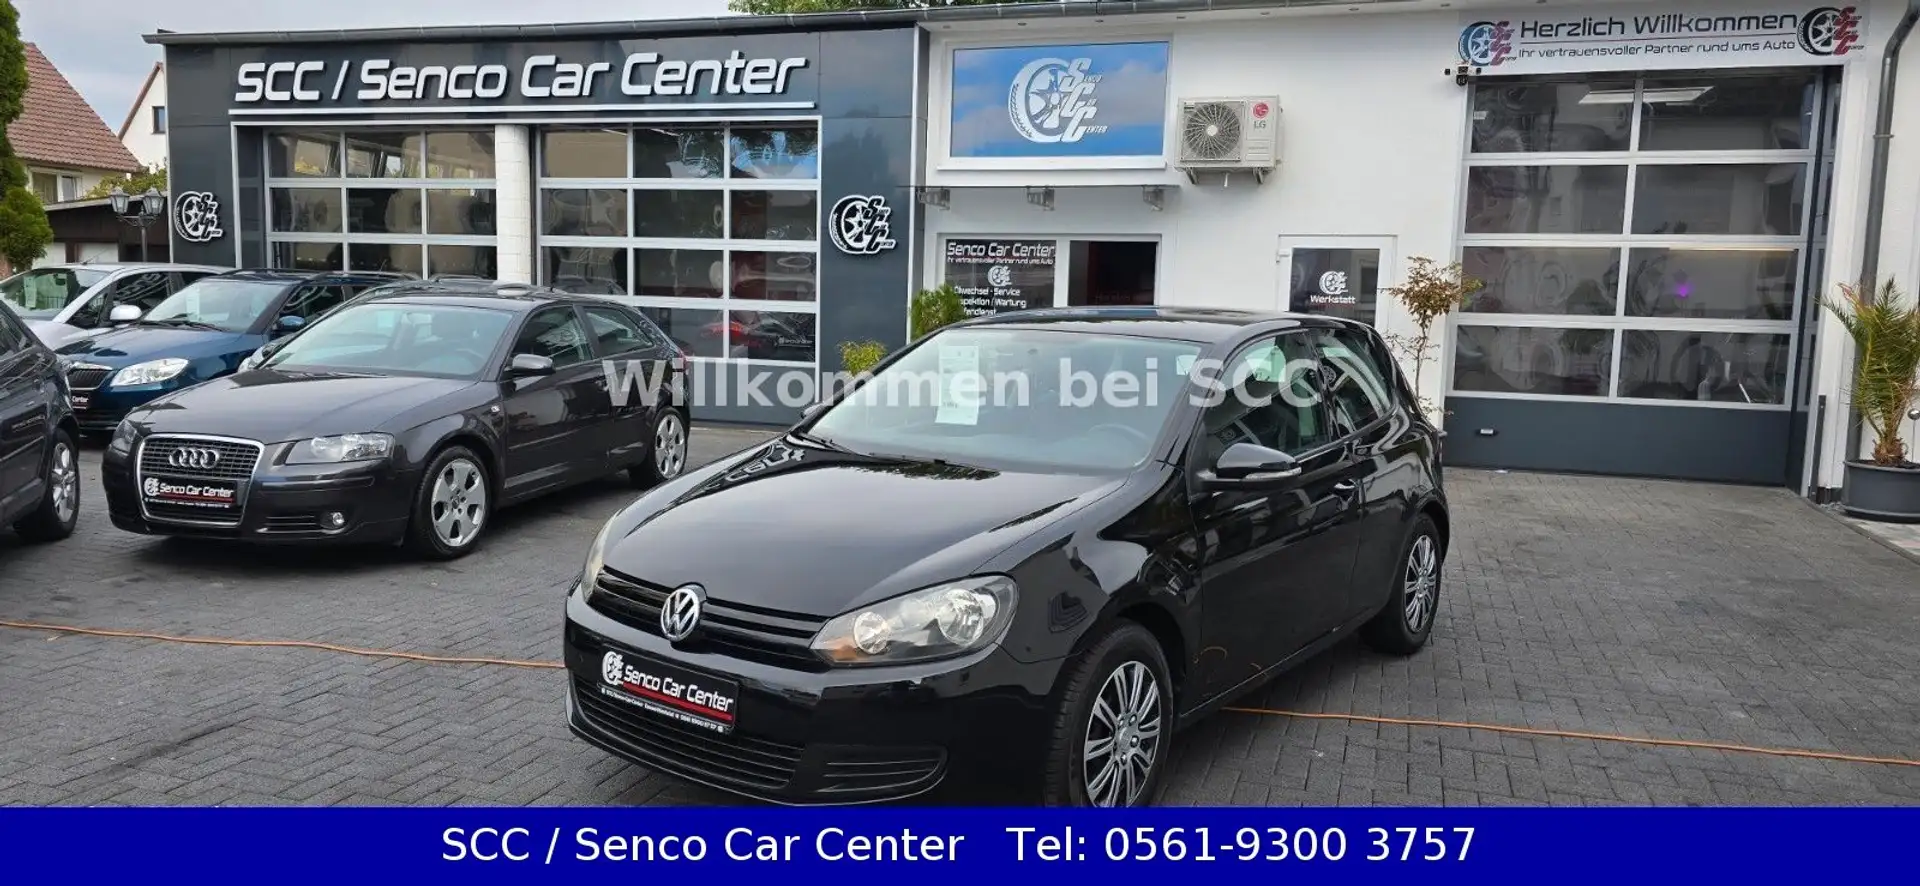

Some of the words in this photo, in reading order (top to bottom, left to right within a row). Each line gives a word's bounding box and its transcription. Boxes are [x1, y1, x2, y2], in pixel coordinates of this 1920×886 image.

[1520, 17, 1625, 38] Herzlich
[1633, 13, 1797, 34] Willkommen
[1519, 49, 1535, 58] Ihr
[1538, 45, 1641, 58] vertrauensvoller
[1644, 44, 1694, 54] Partner
[1696, 41, 1729, 53] rund
[1732, 41, 1760, 51] ums
[1763, 40, 1796, 51] Auto
[235, 61, 324, 101] SCC
[331, 60, 349, 100] /
[357, 59, 508, 100] Senco
[520, 55, 610, 97] Car
[621, 50, 807, 95] Center
[1253, 120, 1266, 129] LG
[947, 241, 986, 257] Senco
[987, 242, 1011, 257] Car
[1012, 242, 1055, 257] Center
[994, 287, 1020, 296] Service
[1310, 294, 1356, 304] Werkstatt
[160, 483, 185, 494] Senco
[186, 485, 202, 496] Car
[203, 486, 234, 498] Center
[623, 665, 661, 691] Senco
[662, 677, 686, 698] Car
[687, 684, 734, 712] Center
